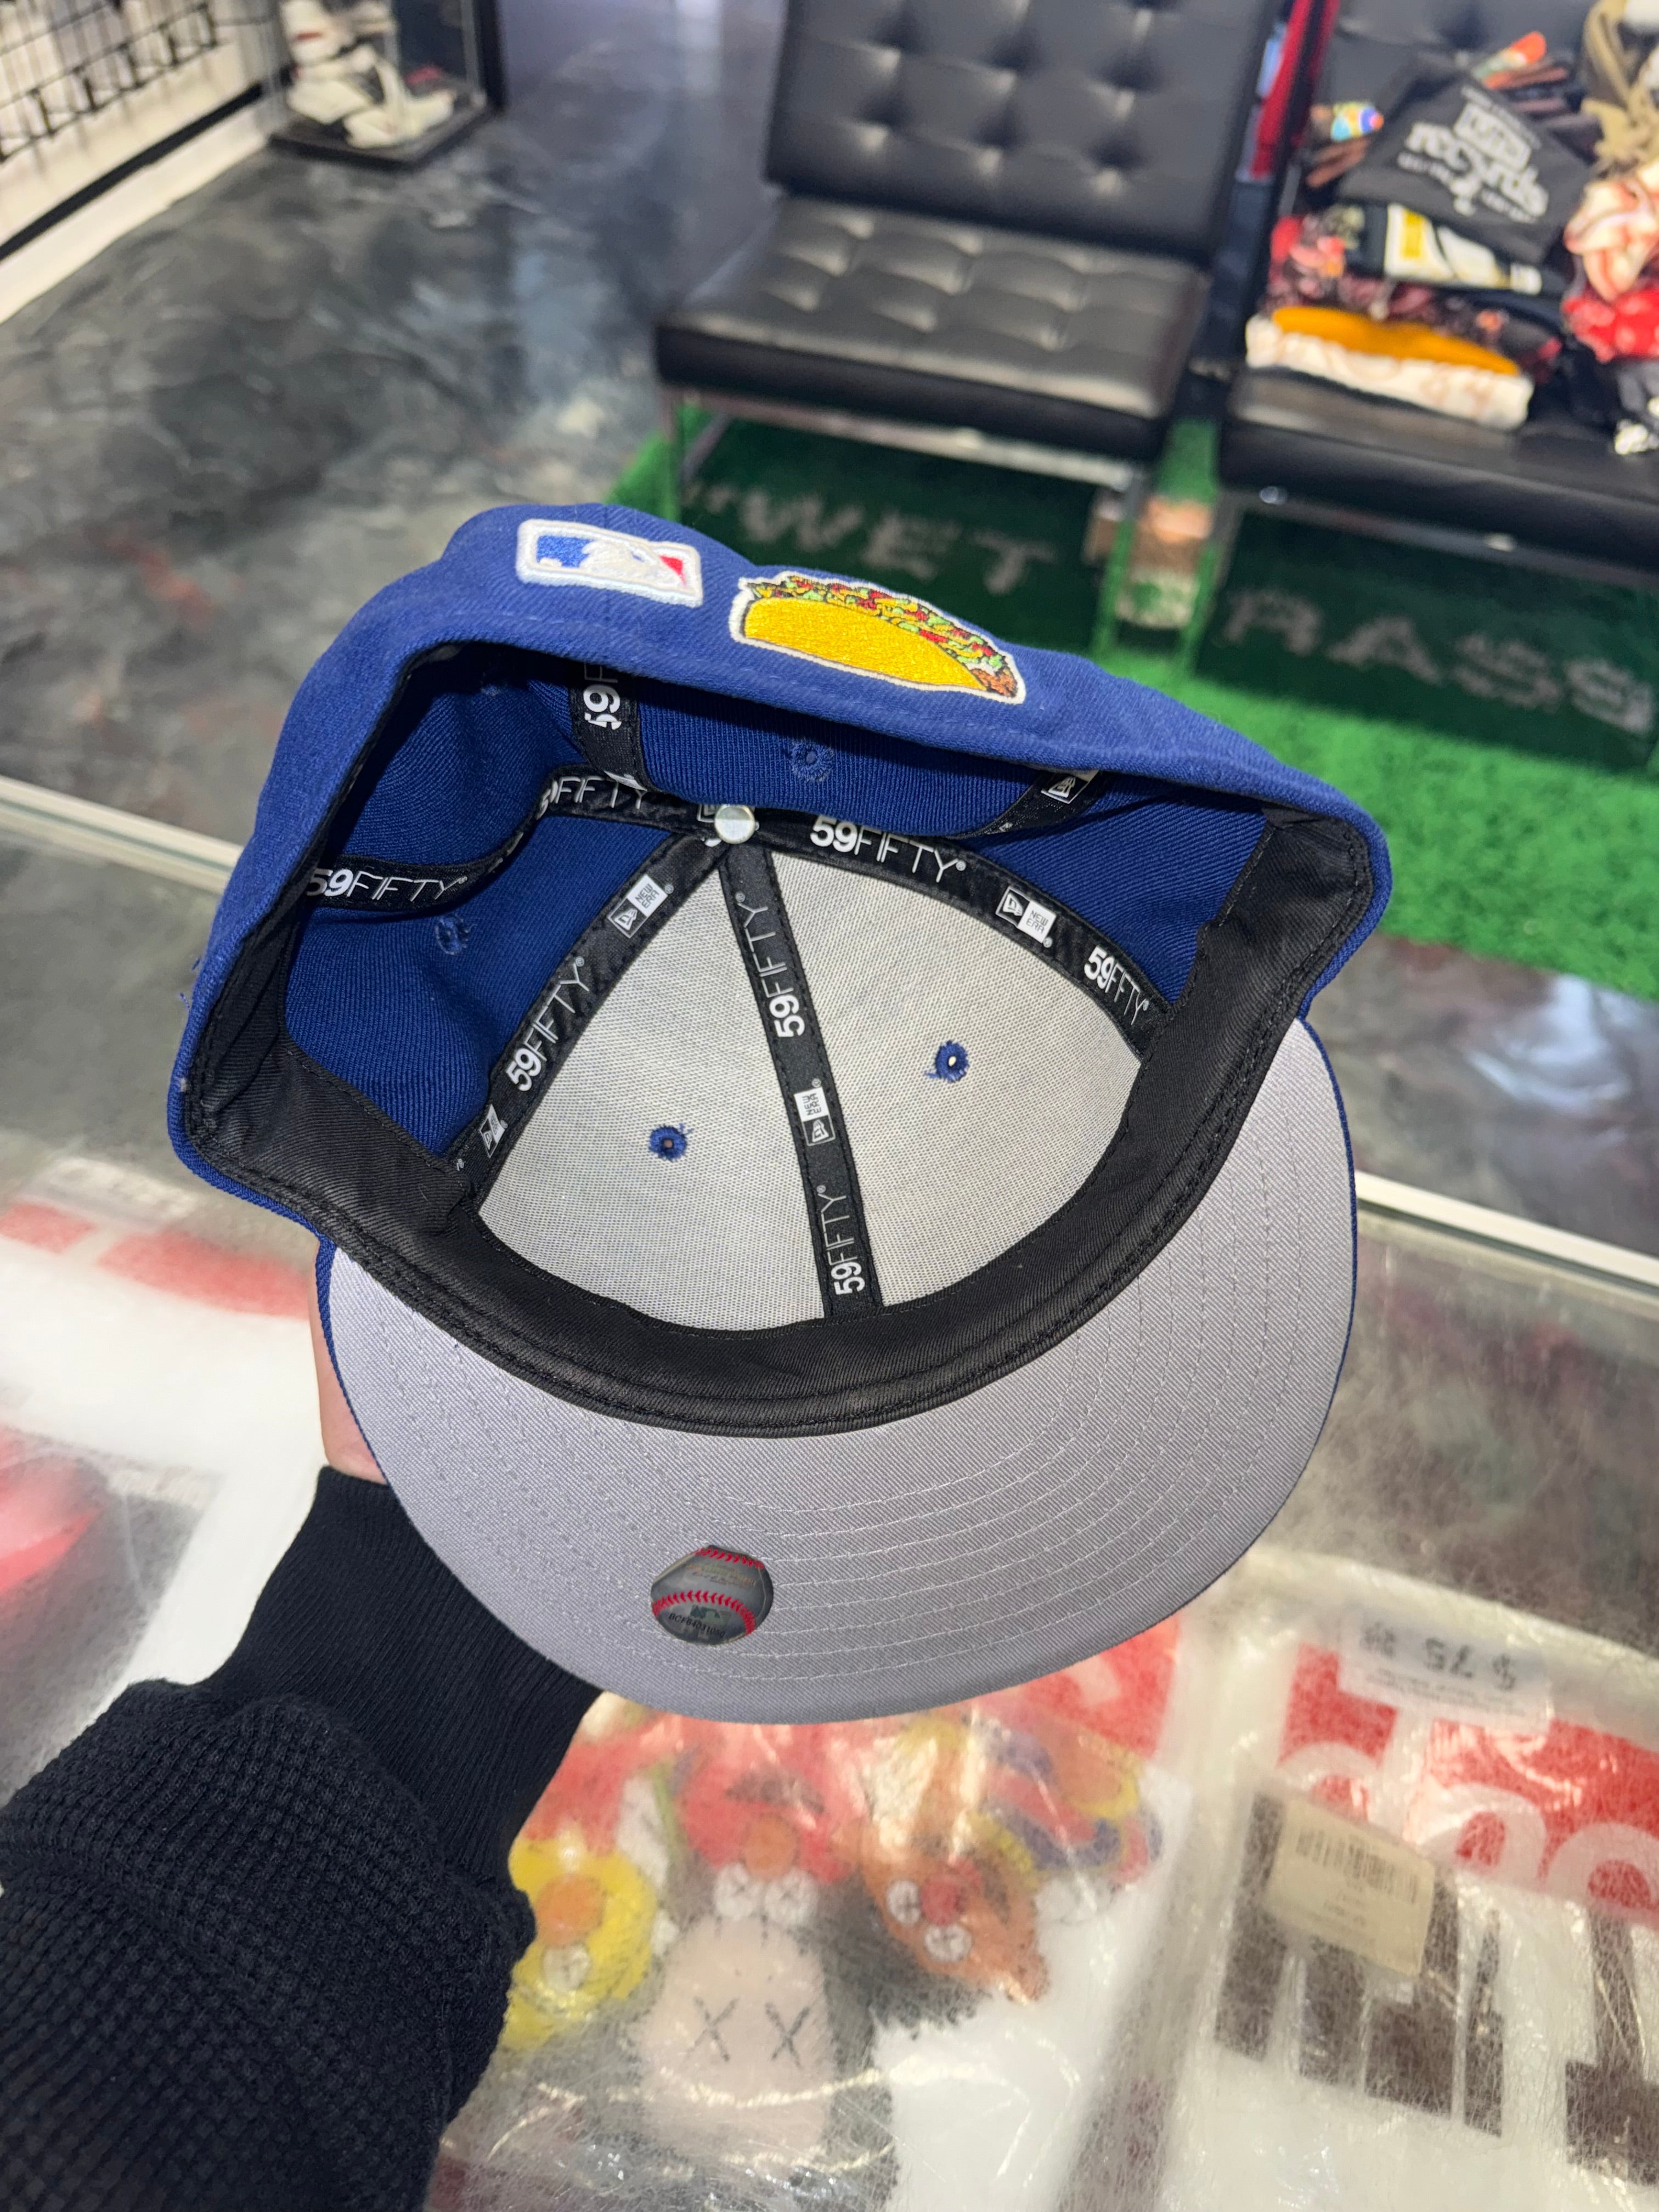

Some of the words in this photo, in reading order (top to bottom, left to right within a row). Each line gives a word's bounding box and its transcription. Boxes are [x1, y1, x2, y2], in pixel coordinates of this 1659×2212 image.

[635, 883, 653, 904] NEW
[641, 889, 660, 909] ERA
[1026, 917, 1045, 934] ERA
[1030, 910, 1049, 927] NEW
[802, 1095, 814, 1116] NEW
